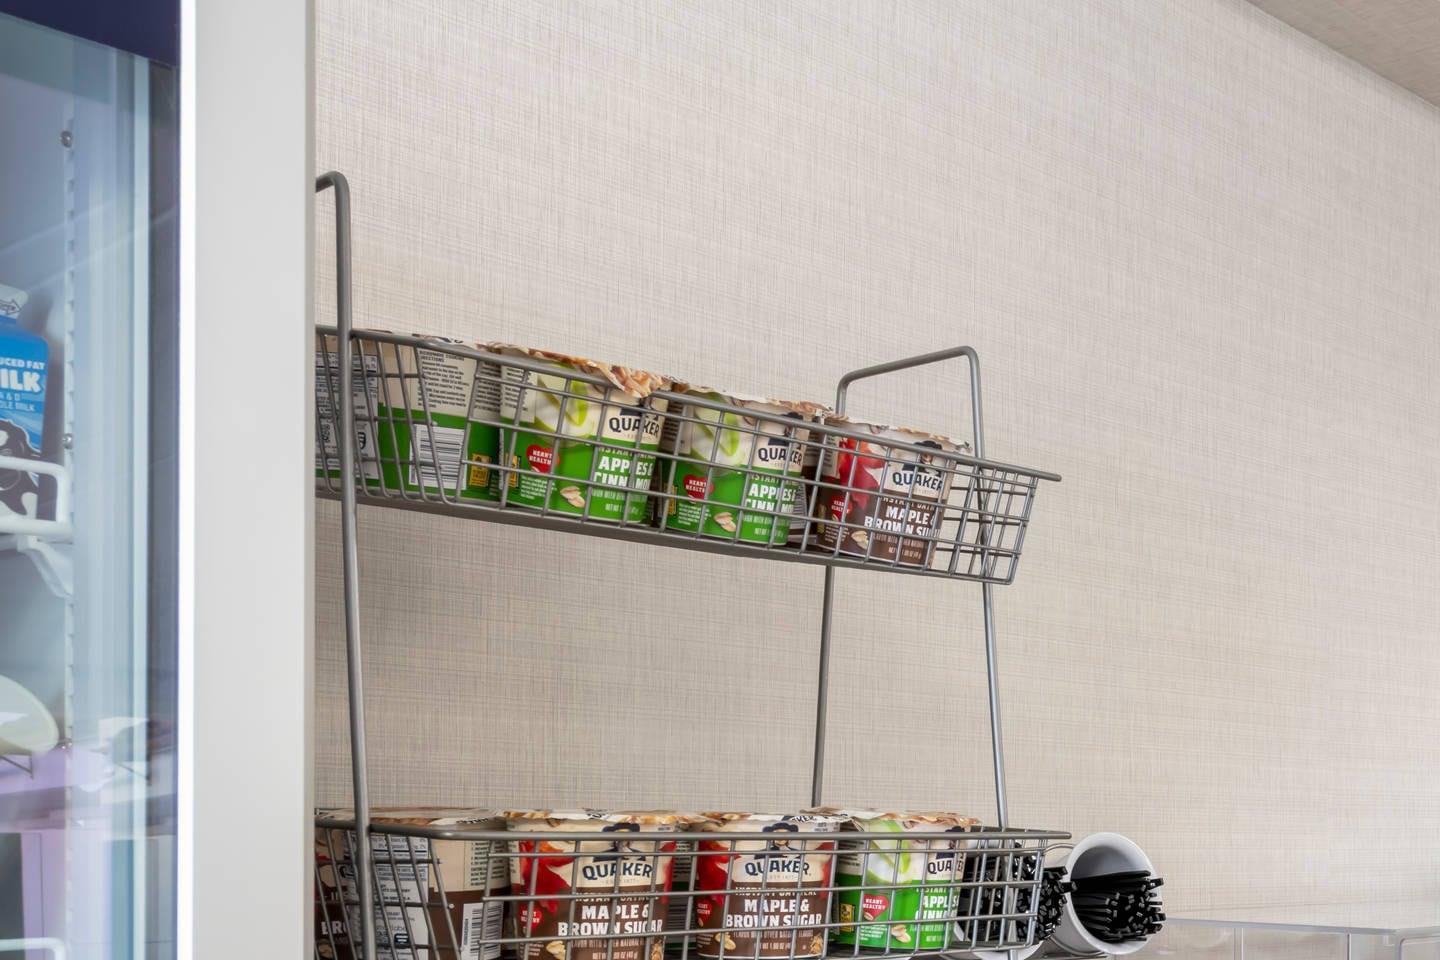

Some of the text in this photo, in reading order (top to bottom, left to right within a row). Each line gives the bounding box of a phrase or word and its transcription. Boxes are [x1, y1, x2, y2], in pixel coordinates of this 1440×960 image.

[26, 360, 46, 370] FAT
[608, 416, 660, 438] QUAKER
[529, 455, 552, 465] HEALTH
[598, 455, 648, 476] APPES
[582, 862, 653, 881] QUAKER
[744, 859, 813, 877] QUAKER
[581, 905, 641, 920] MAPLE
[744, 899, 810, 912] MAPLE &
[726, 913, 822, 928] BROWN SGAR
[558, 921, 620, 937] BROWN
